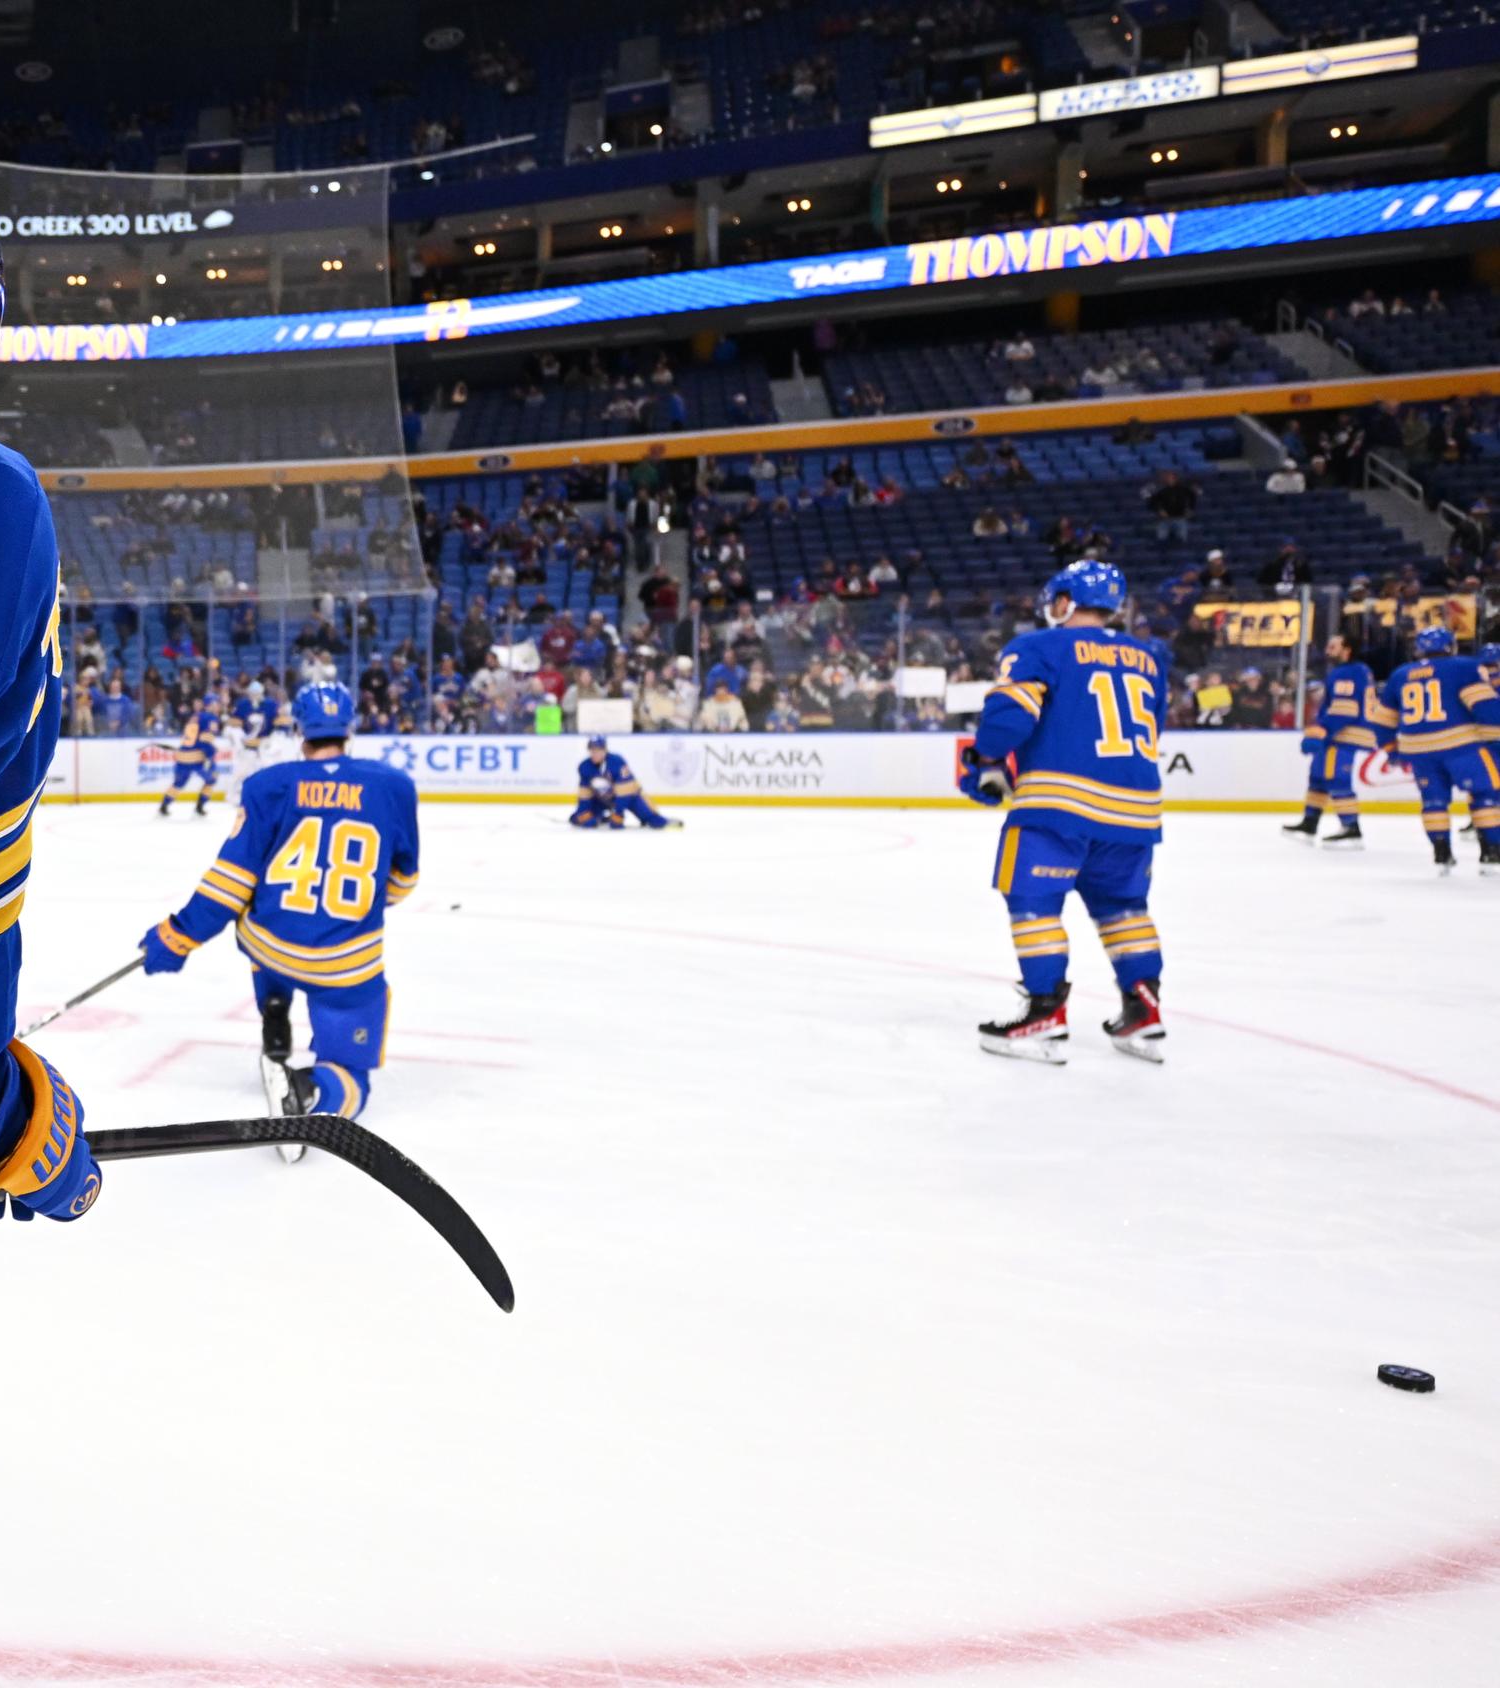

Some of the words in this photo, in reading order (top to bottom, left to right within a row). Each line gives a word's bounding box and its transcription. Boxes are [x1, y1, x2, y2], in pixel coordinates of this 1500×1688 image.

[1150, 72, 1195, 90] GO
[16, 214, 86, 236] CREEK
[87, 213, 131, 235] 300
[134, 211, 198, 235] LEVEL
[788, 255, 888, 289] TAGE
[906, 212, 1177, 286] THOMPSON
[1087, 670, 1159, 764] 15
[1401, 679, 1447, 725] 91
[426, 744, 527, 772] CFBT
[296, 780, 364, 811] KOZAK
[265, 816, 381, 922] 48
